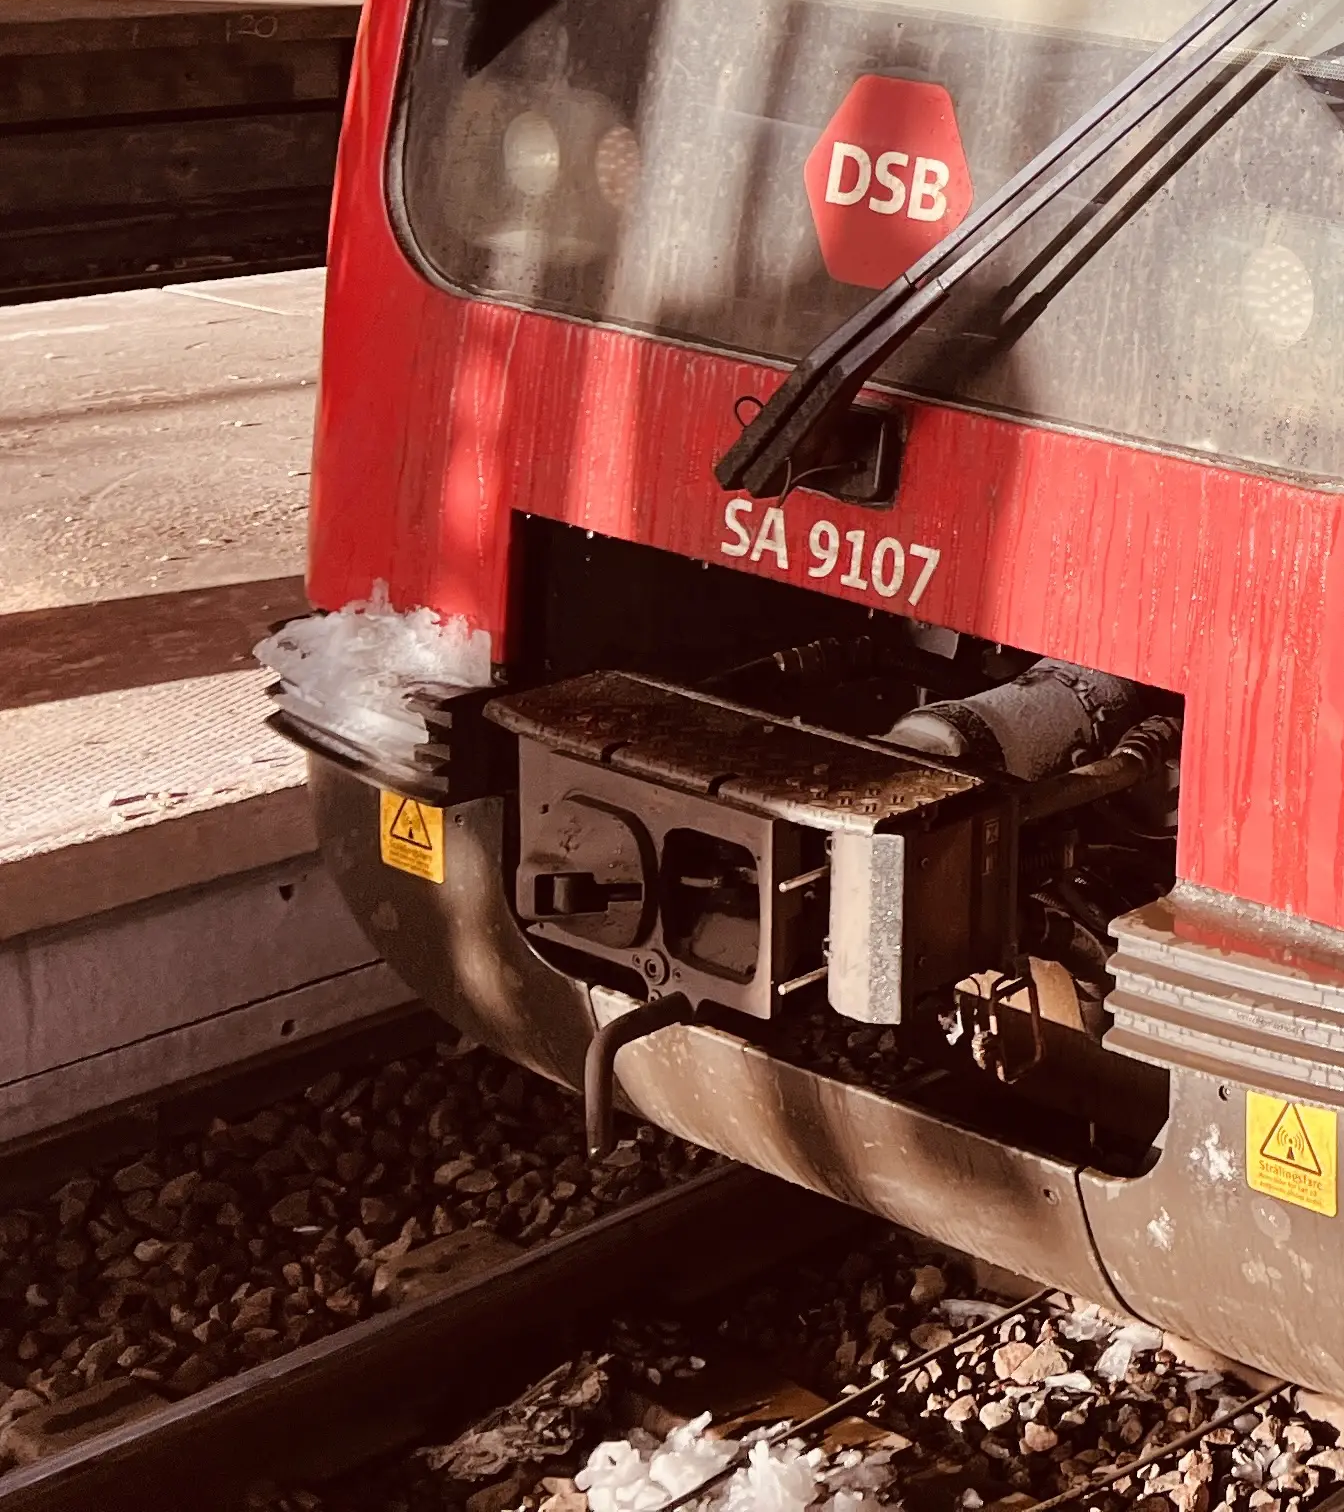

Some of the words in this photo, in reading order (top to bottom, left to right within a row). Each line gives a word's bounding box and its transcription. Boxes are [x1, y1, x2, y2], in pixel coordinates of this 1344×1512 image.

[825, 141, 949, 222] DSB
[721, 498, 788, 570] SA
[808, 520, 941, 607] 9107
